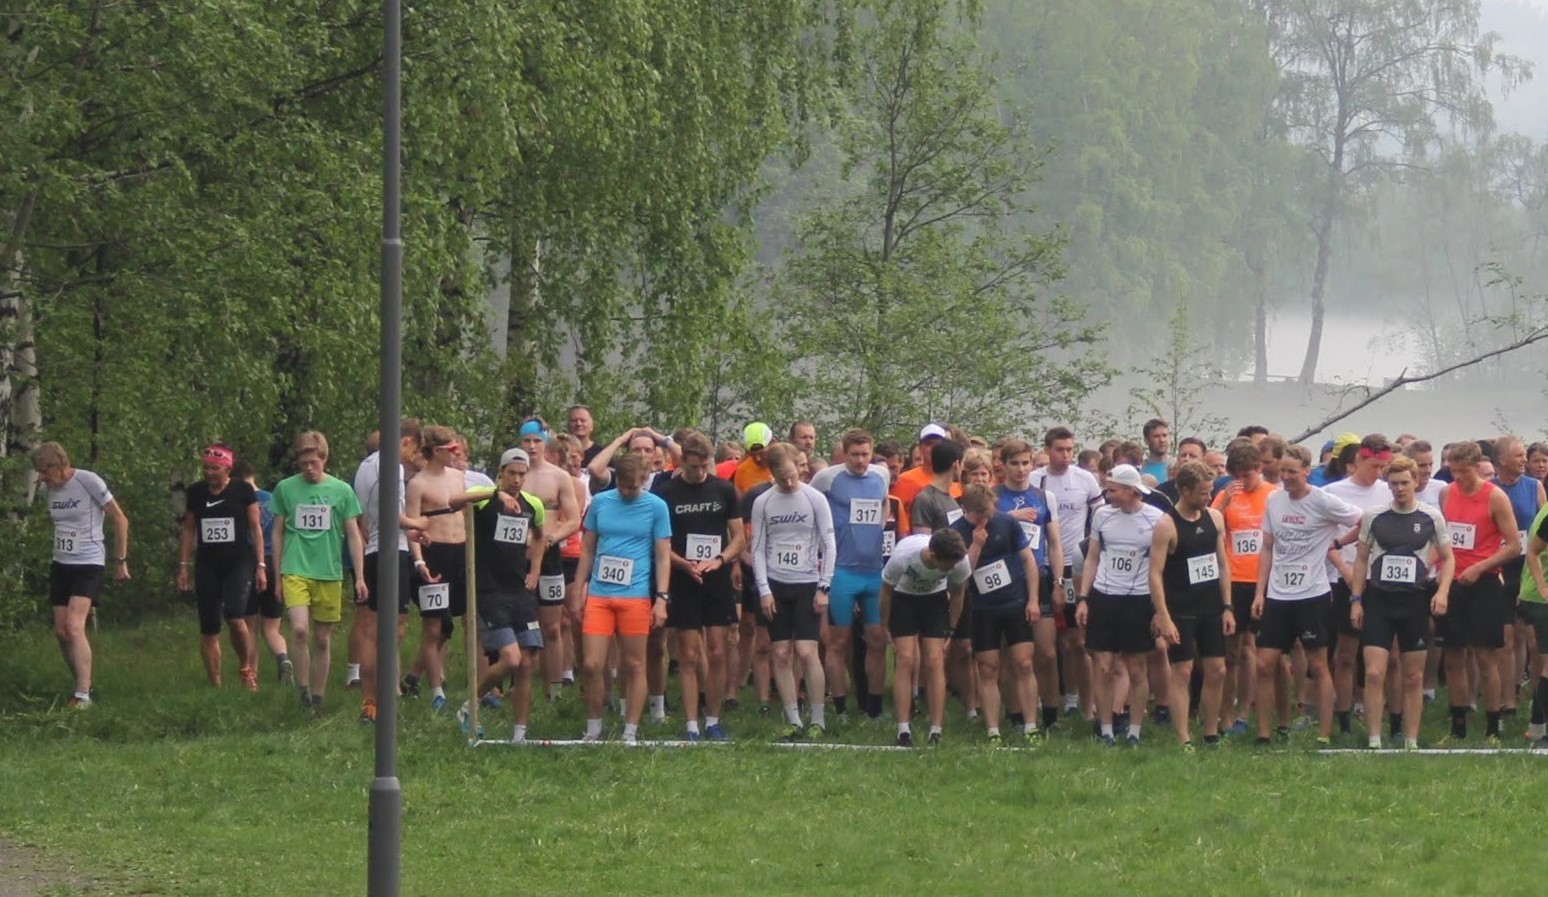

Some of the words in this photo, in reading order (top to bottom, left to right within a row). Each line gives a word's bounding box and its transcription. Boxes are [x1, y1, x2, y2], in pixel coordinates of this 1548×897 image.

[51, 498, 80, 509] swix
[675, 502, 712, 514] CRAFT
[302, 515, 323, 527] 131
[769, 511, 809, 525] swix
[856, 509, 877, 522] 317
[206, 528, 228, 540] 253
[503, 527, 523, 541] 133
[1452, 532, 1465, 546] 94
[696, 545, 712, 558] 93
[1236, 540, 1257, 553] 136
[777, 552, 798, 565] 148
[1111, 557, 1132, 571] 106
[601, 566, 625, 581] 340
[1195, 564, 1215, 580] 145
[1284, 572, 1305, 585] 127
[1386, 566, 1409, 579] 334
[984, 573, 1002, 589] 98
[549, 585, 562, 598] 58
[427, 594, 442, 607] 70
